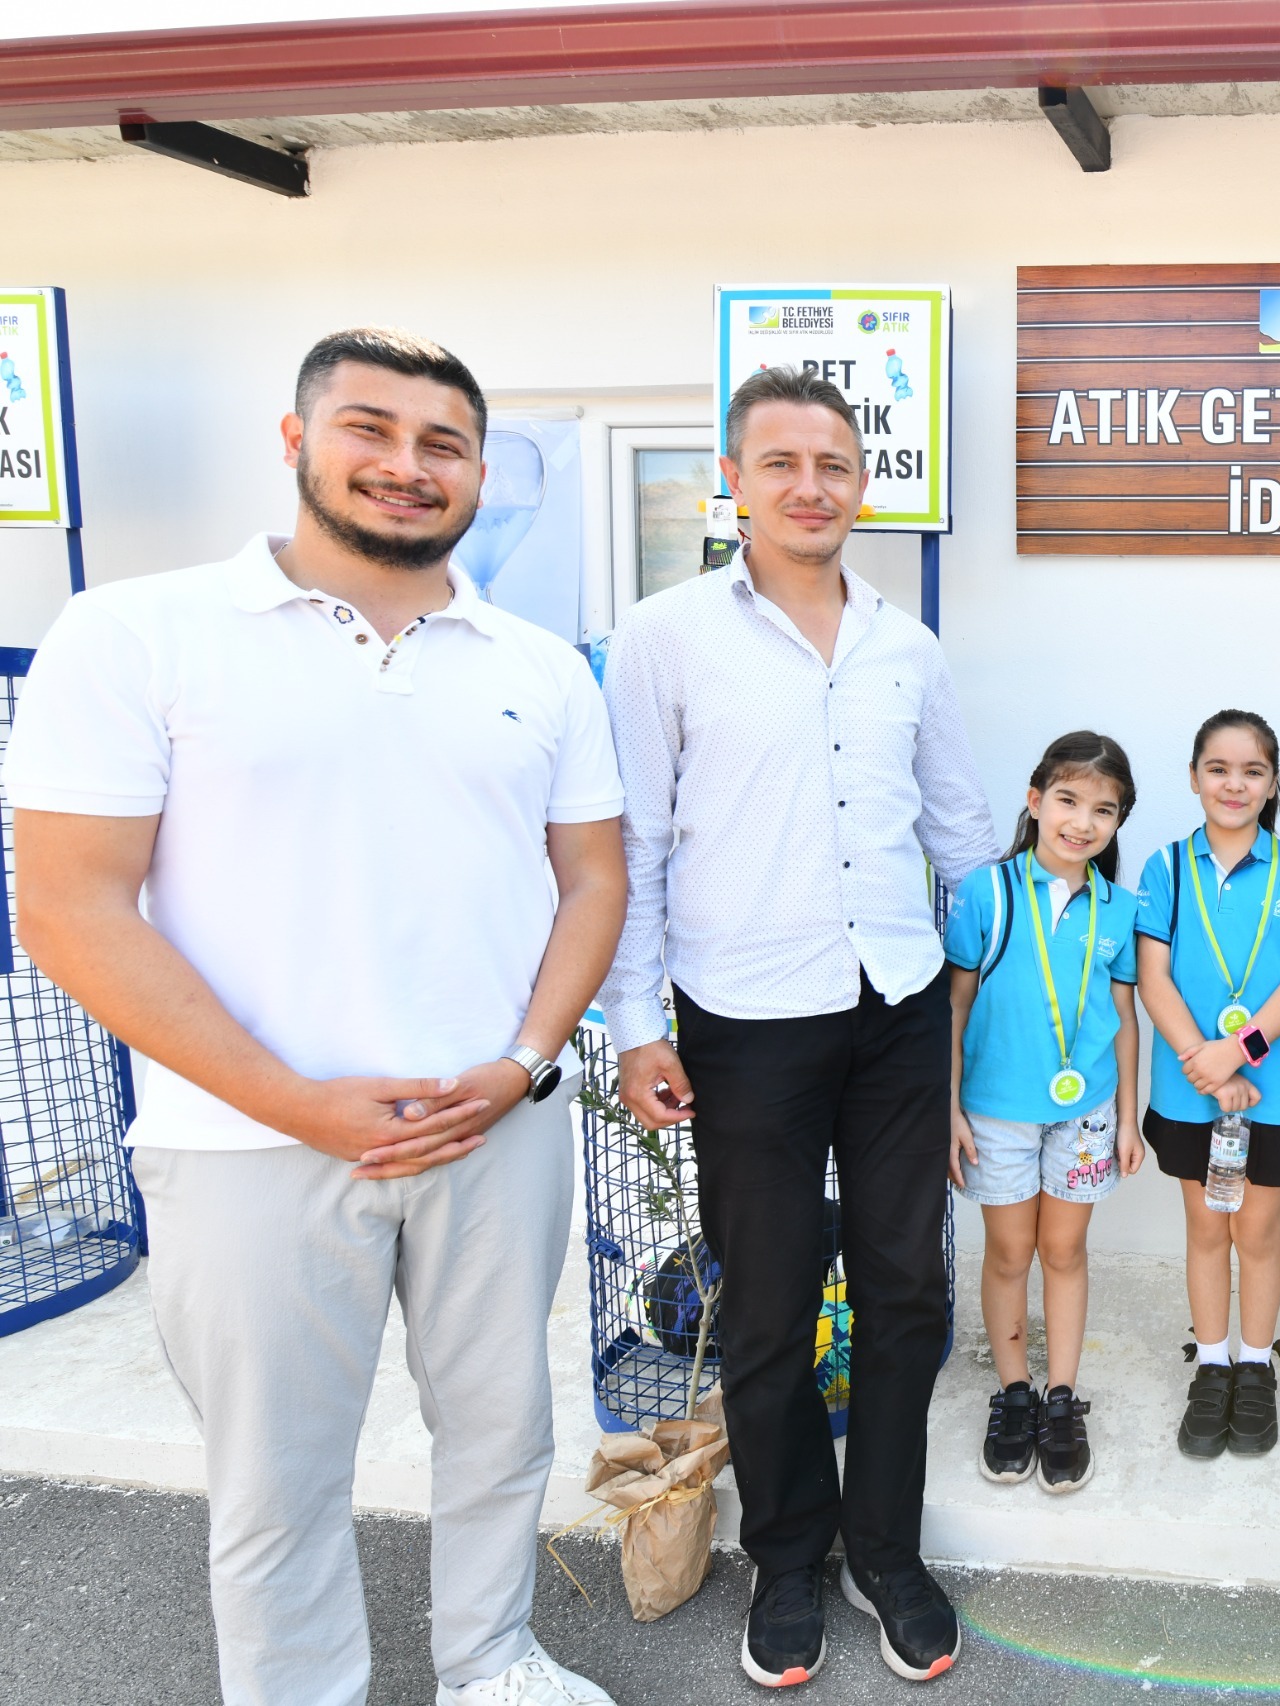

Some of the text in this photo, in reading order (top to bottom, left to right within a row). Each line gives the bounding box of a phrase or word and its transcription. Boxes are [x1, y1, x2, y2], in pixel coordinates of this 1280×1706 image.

[882, 311, 910, 322] SIFIR
[882, 322, 910, 332] ATIK
[1048, 388, 1183, 446] ATIK
